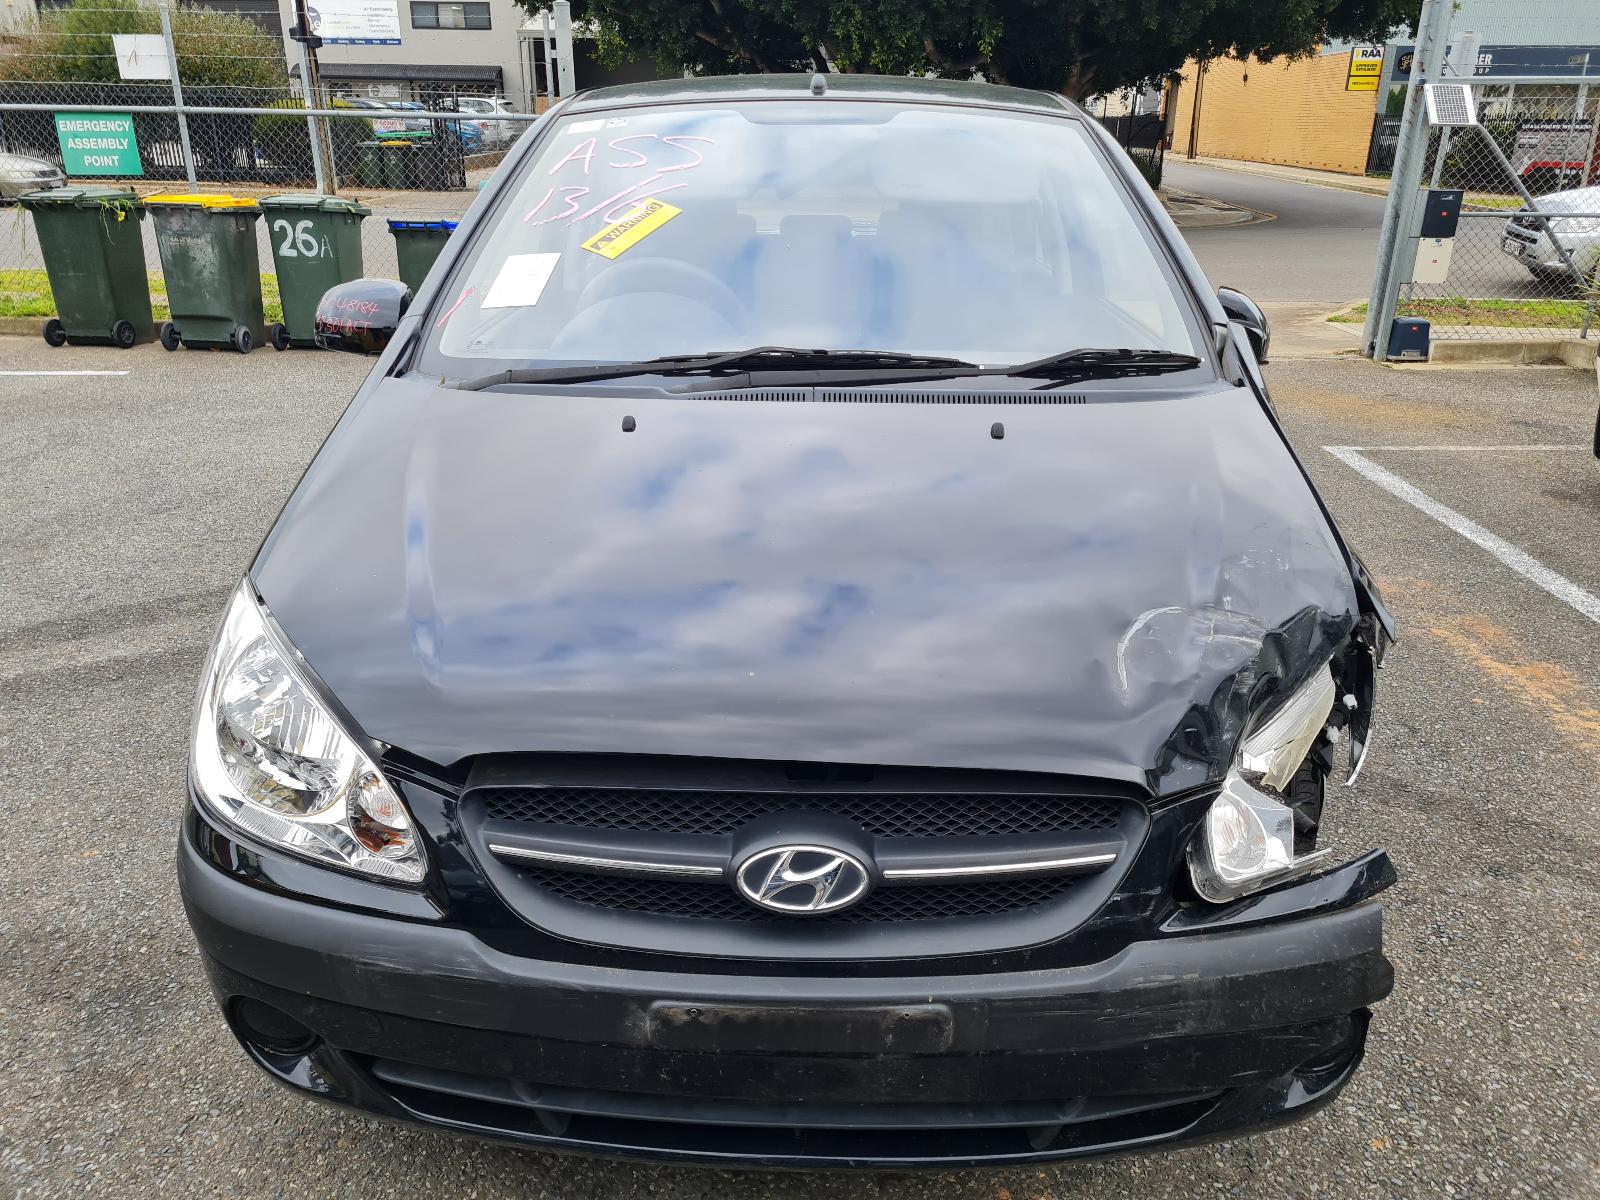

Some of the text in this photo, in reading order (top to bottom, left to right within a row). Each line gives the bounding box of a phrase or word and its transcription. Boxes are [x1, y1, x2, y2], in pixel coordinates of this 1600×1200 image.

[1361, 50, 1381, 58] RAA
[60, 120, 130, 132] EMERGENCY
[67, 138, 129, 150] ASSEMBLY
[550, 134, 715, 175] ASS
[83, 155, 120, 167] POINT
[607, 203, 662, 240] WARNING
